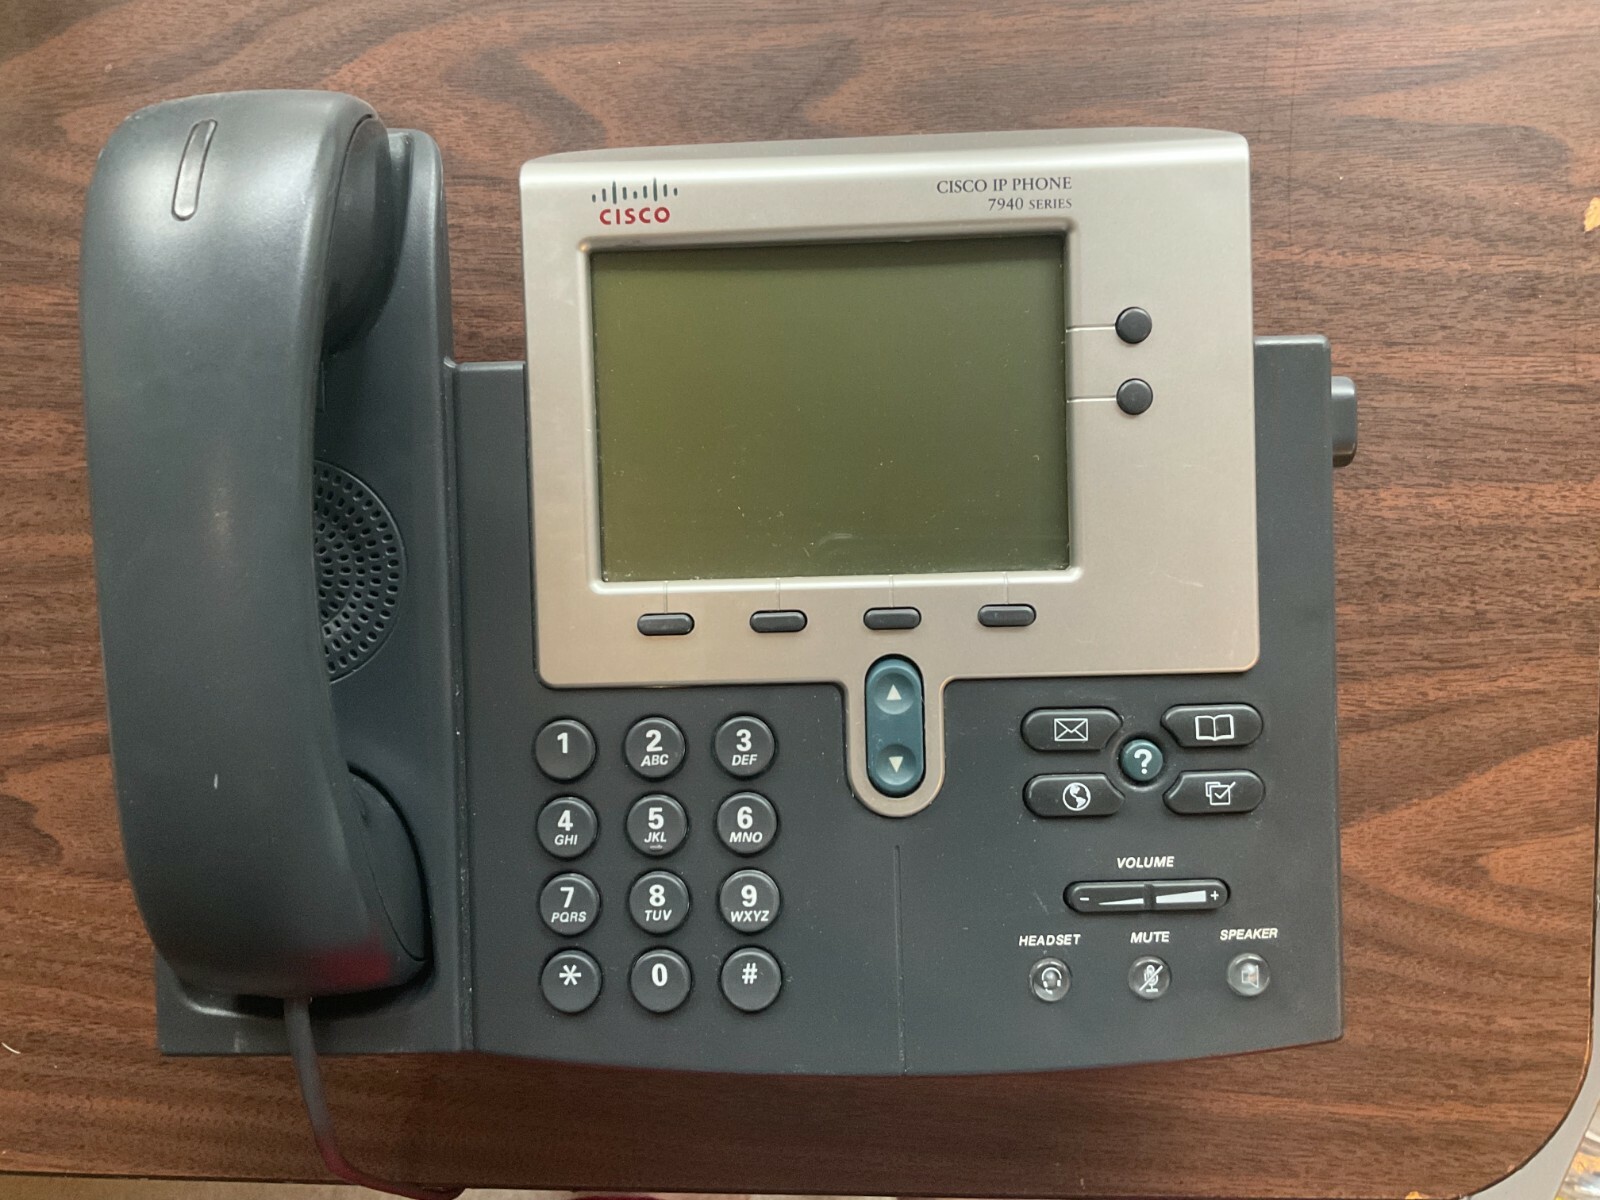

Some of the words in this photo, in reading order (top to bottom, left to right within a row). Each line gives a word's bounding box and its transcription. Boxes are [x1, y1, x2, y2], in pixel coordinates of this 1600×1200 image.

[936, 180, 988, 195] CISCO
[993, 179, 1008, 192] IP
[1012, 176, 1073, 192] PHONE
[988, 197, 1025, 212] 7940
[1029, 199, 1073, 210] SERIES
[600, 207, 671, 226] CISCO
[557, 732, 569, 754] 1
[645, 730, 663, 752] 2
[736, 729, 752, 752] 3
[641, 754, 669, 767] ABC
[732, 754, 758, 766] DEF
[558, 810, 574, 831] 4
[648, 808, 664, 830] 5
[737, 806, 753, 830] 6
[554, 835, 578, 846] GHI
[644, 832, 667, 843] JKL
[729, 832, 763, 844] MNO
[1117, 856, 1175, 869] VOLUME
[560, 887, 575, 908] 7
[649, 884, 666, 908] 8
[741, 885, 757, 908] 9
[551, 911, 587, 923] PQRS
[645, 910, 672, 921] TUV
[730, 911, 770, 922] WXYZ
[1019, 934, 1081, 946] HEADSET
[1130, 932, 1170, 944] MUTE
[1220, 928, 1279, 941] SPEAKER
[651, 963, 668, 987] 0
